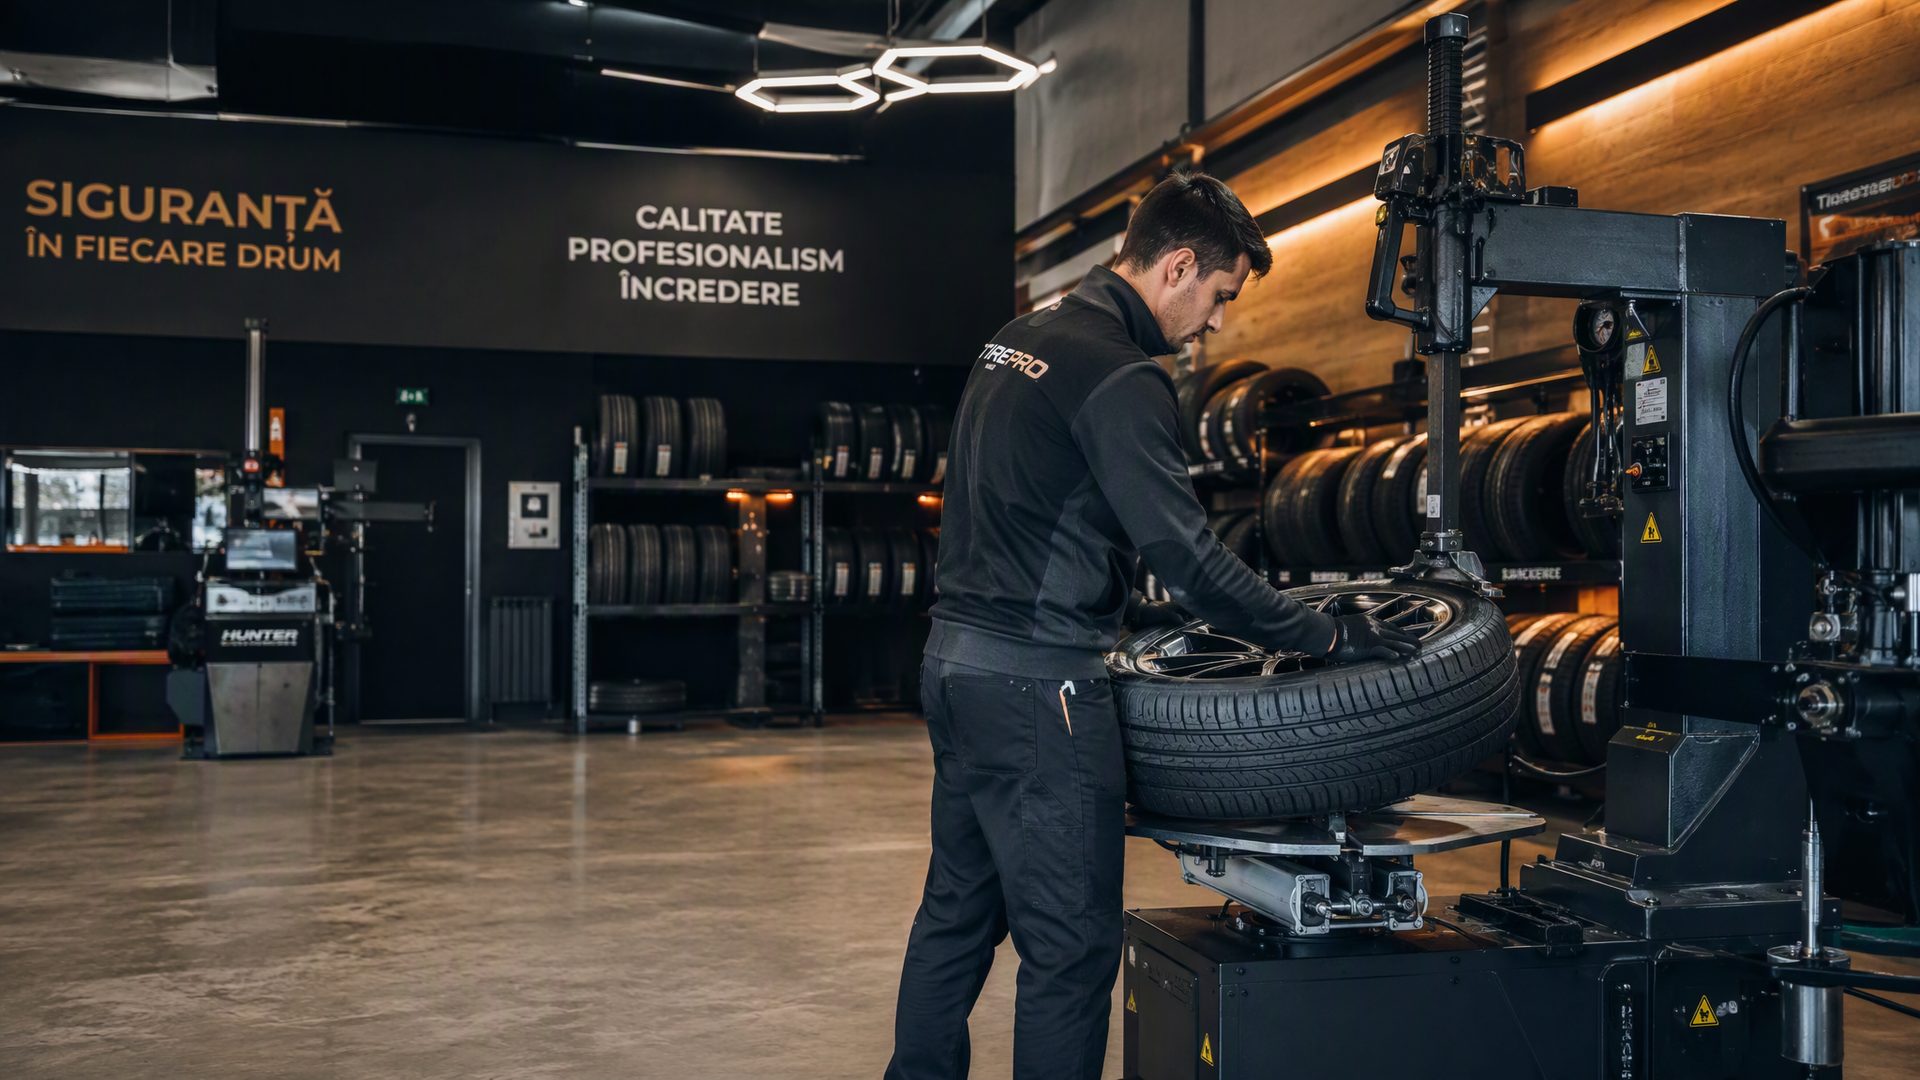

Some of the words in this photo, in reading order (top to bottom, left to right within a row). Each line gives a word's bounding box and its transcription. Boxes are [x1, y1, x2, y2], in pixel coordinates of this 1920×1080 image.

[25, 179, 343, 243] SIGURANȚĂ
[635, 204, 783, 236] CALITATE
[25, 226, 63, 258] ÎN
[75, 234, 227, 267] FIECARE
[237, 244, 341, 272] DRUM
[567, 236, 845, 273] PROFESIONALISM
[618, 269, 801, 307] ÎNCREDERE
[978, 343, 1049, 379] TIREPRO
[221, 628, 299, 642] HUNTER
